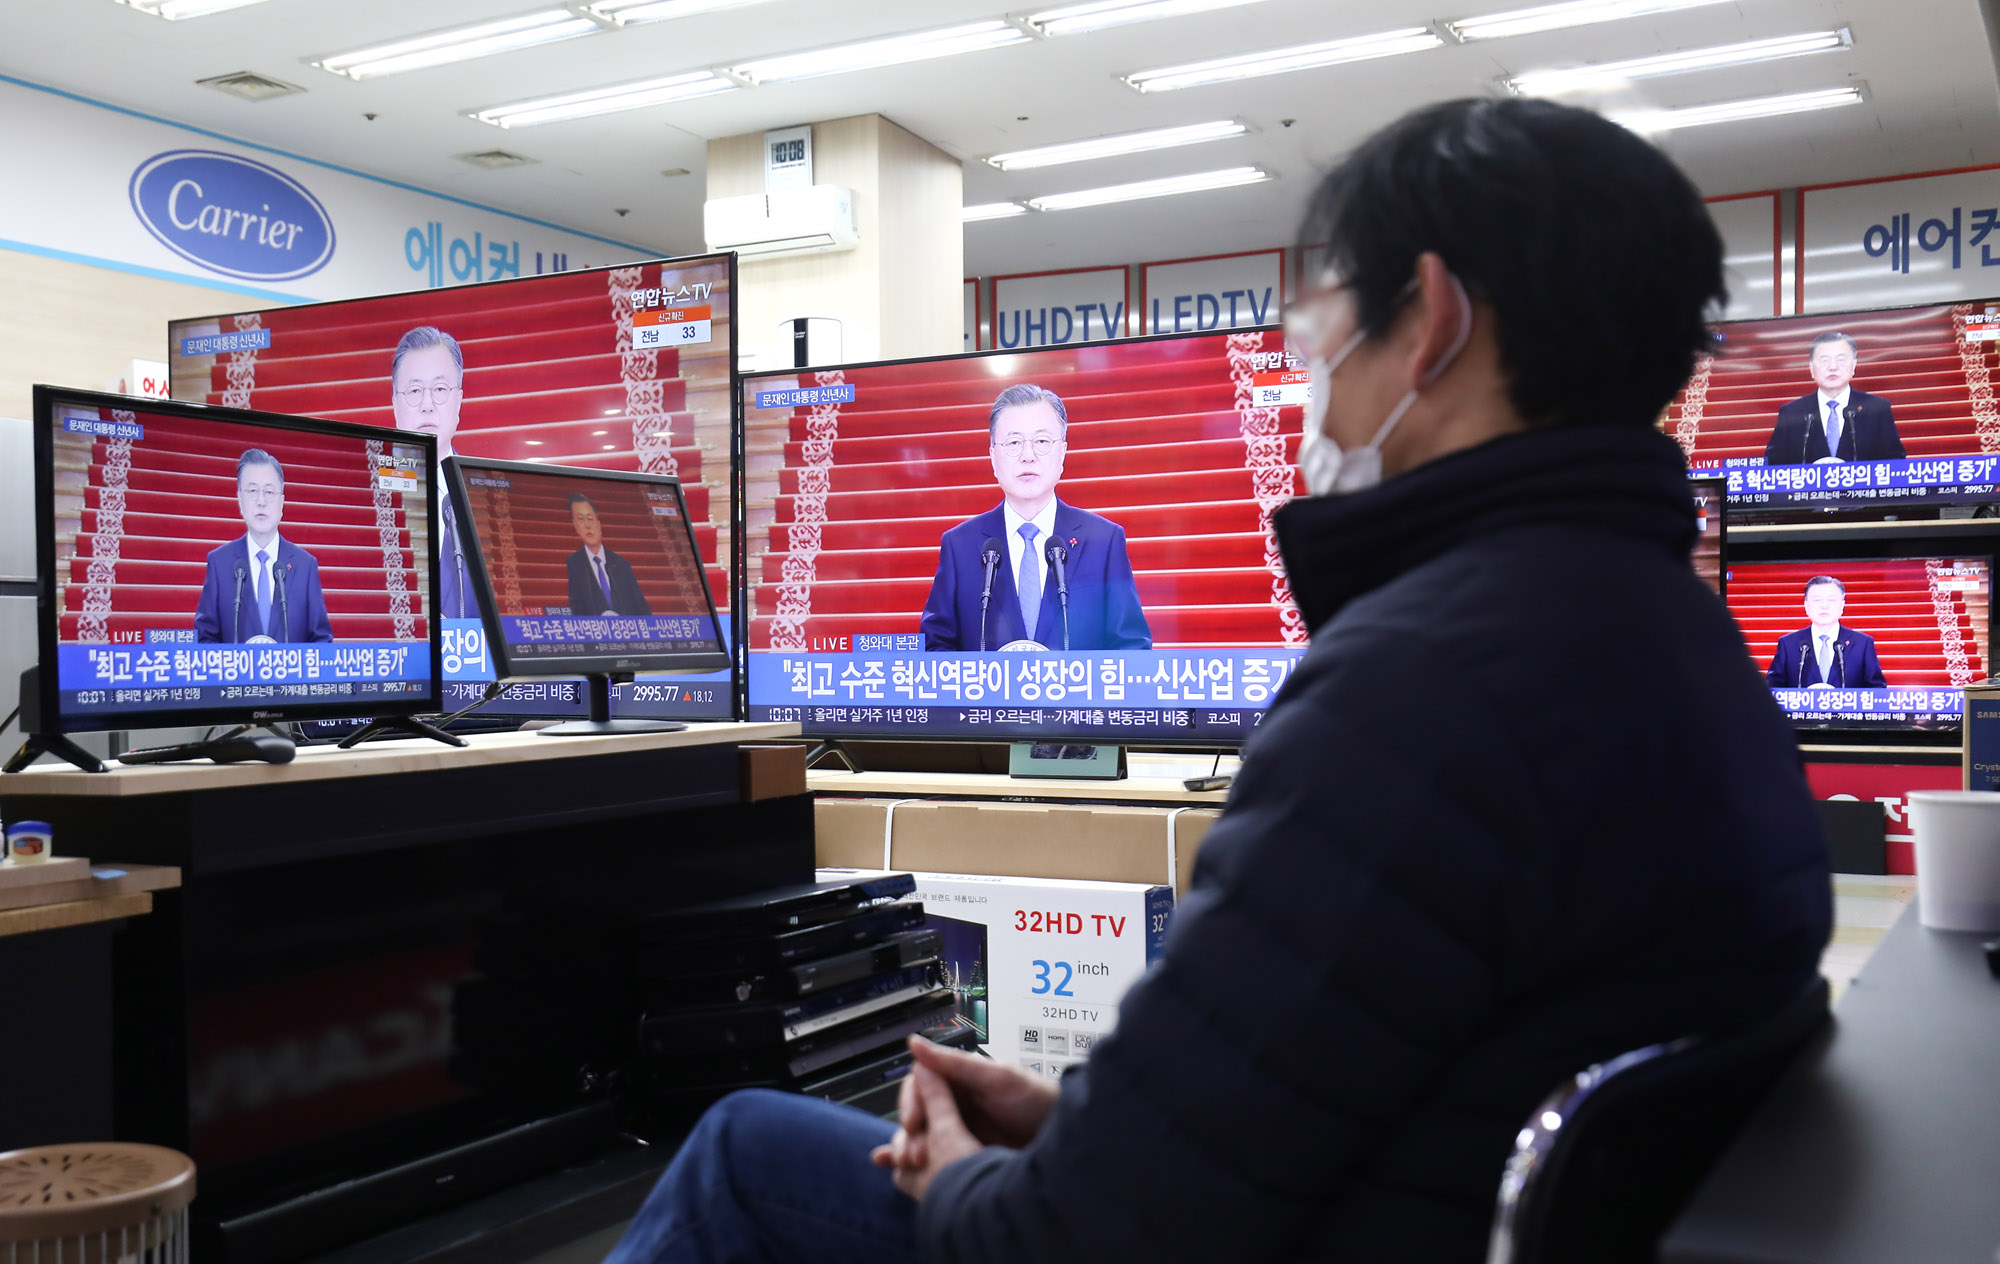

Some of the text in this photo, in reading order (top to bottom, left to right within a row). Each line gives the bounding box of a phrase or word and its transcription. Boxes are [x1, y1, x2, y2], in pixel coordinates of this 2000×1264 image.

[168, 179, 303, 250] Carrier
[631, 282, 712, 308] 연합뉴스TV
[1153, 287, 1272, 335] LEDTV
[641, 326, 696, 343] 전남 33
[1000, 301, 1124, 349] UHDTV
[187, 333, 265, 354] 문재인 대통령 신년사
[1251, 352, 1301, 370] 연합뉴
[762, 387, 849, 406] 문재인 대통령 신년사
[1263, 389, 1282, 401] 전남
[69, 419, 139, 437] 문재인 대통령 신년사
[1696, 460, 1719, 469] LIVE
[1746, 466, 1821, 491] 혁신역량이
[1824, 464, 1871, 487] 성장의
[1964, 485, 1993, 494] 2995.77
[114, 631, 142, 643] LIVE
[150, 630, 194, 643] 청와대 본관
[543, 620, 564, 640] 수준
[611, 619, 640, 640] 성장의
[813, 636, 848, 650] LIVE
[858, 635, 920, 651] 청와대 본관
[89, 649, 133, 683] "최고
[135, 650, 171, 682] 수준
[174, 648, 254, 682] 혁신역량이
[258, 648, 302, 680] 성장의
[377, 647, 408, 677] 증가"
[783, 659, 836, 699] "최고
[840, 660, 886, 699] 수준
[891, 659, 1010, 700] 혁신역량이
[1016, 658, 1092, 701] 성장의
[115, 690, 142, 702] 올리면
[143, 688, 169, 701] 실거주
[170, 688, 183, 700] 1년
[184, 687, 201, 700] 인정
[227, 685, 242, 698] 금리
[383, 682, 406, 692] 2995.77
[550, 683, 576, 702] 비중
[633, 685, 679, 702] 2995.77
[1775, 691, 1814, 710] 역량이
[1817, 690, 1857, 710] 성장의
[769, 707, 801, 722] 10:07
[814, 707, 848, 722] 올리면
[850, 708, 883, 723] 실거주
[886, 708, 902, 722] 1년
[905, 708, 929, 723] 인정
[967, 709, 991, 724] 금리
[1108, 709, 1158, 726] 변동금리
[1163, 709, 1189, 726] 비중
[1207, 711, 1241, 726] 코스피
[1014, 909, 1126, 938] 32HD TV
[1031, 959, 1109, 997] 32 inch
[1042, 1006, 1099, 1022] 32HD TV
[1024, 1029, 1039, 1038] HD
